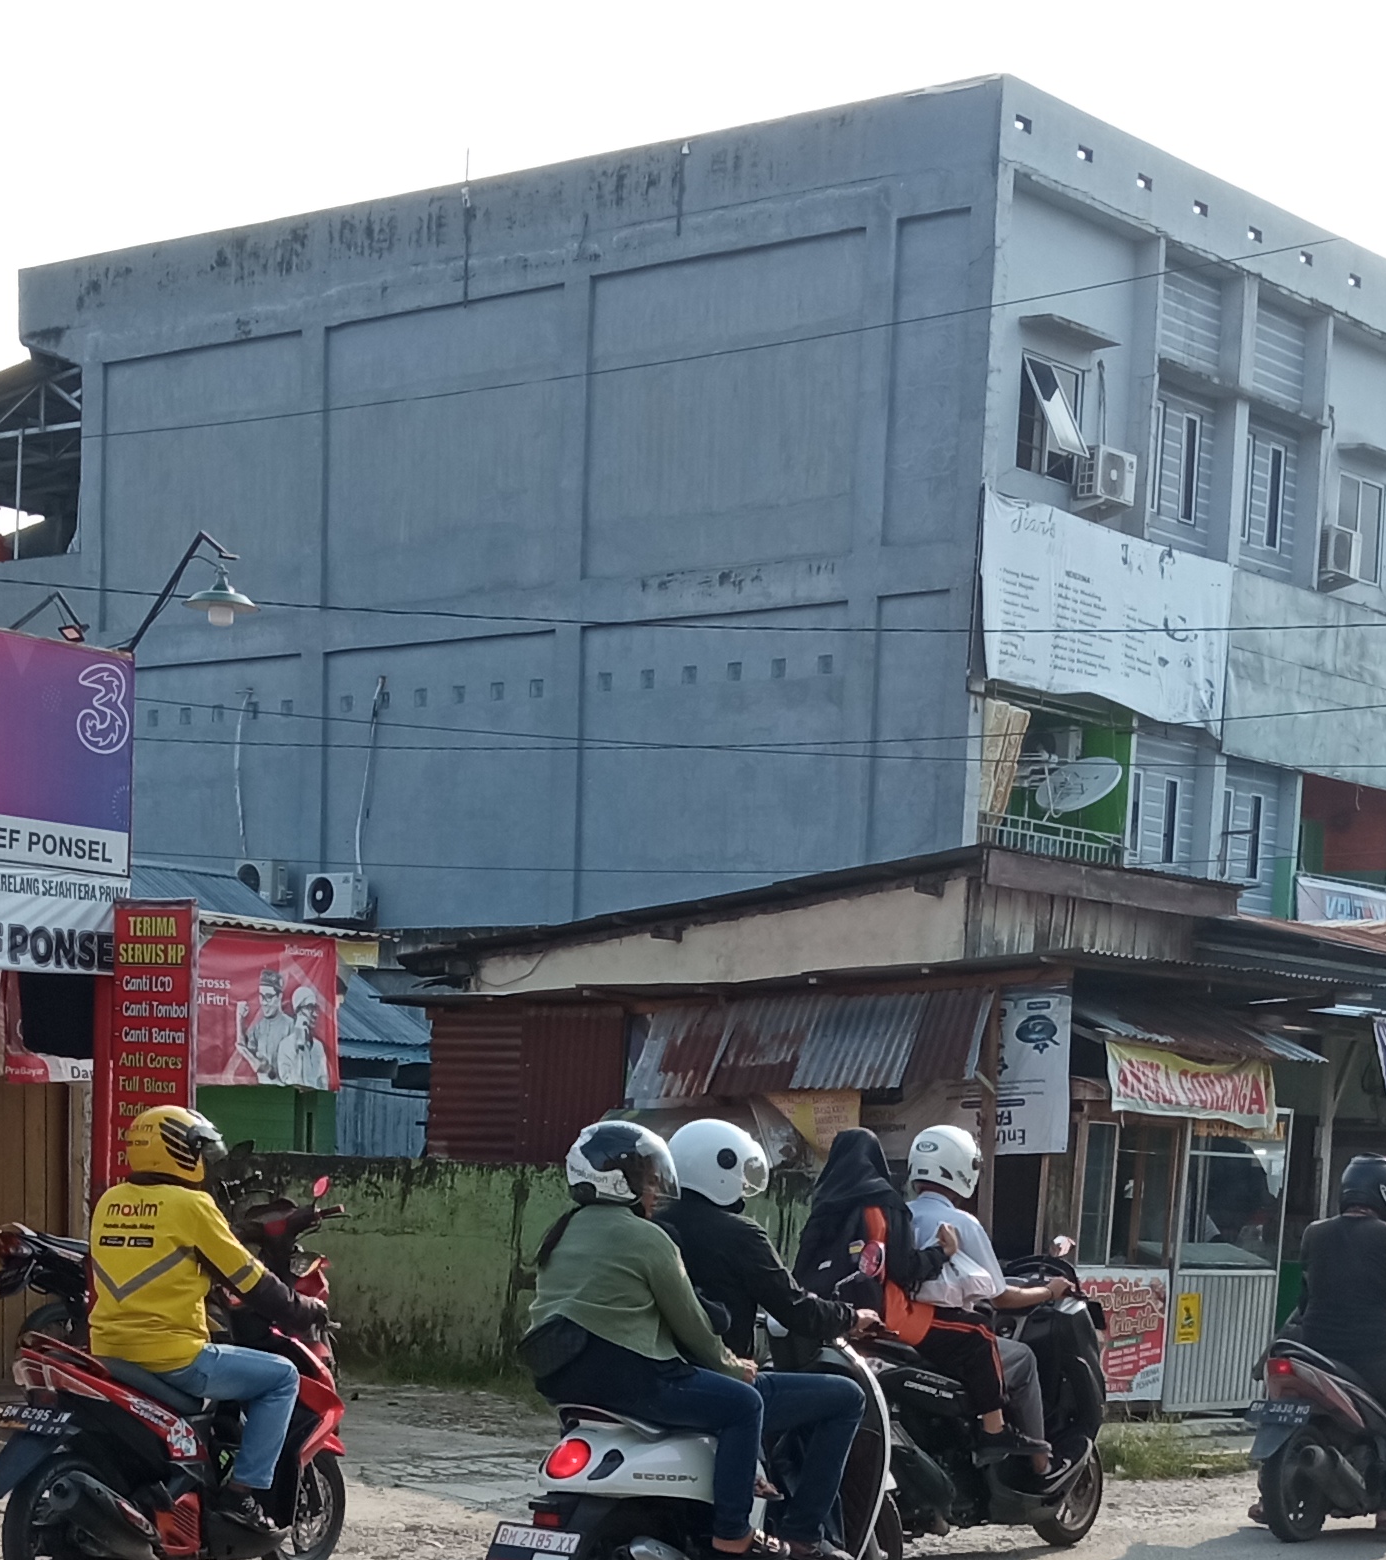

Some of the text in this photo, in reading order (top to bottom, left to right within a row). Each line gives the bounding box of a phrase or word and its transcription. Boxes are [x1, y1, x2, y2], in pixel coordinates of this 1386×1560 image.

[76, 663, 130, 754] 3
[27, 831, 113, 864] PONSEL
[41, 879, 97, 903] SEJAHTERA
[128, 916, 177, 938] TERIMA
[119, 944, 186, 964] SERVIS HP
[152, 976, 173, 992] LCD
[206, 993, 229, 1006] Fitri
[151, 1001, 188, 1019] Tombol
[151, 1027, 185, 1045] Batrai
[119, 1052, 144, 1068] Anti
[119, 1075, 139, 1092] Full
[106, 1198, 158, 1217] maxim
[632, 1472, 699, 1484] SCOOPY
[519, 1531, 555, 1549] 2185
[556, 1537, 576, 1552] XX
